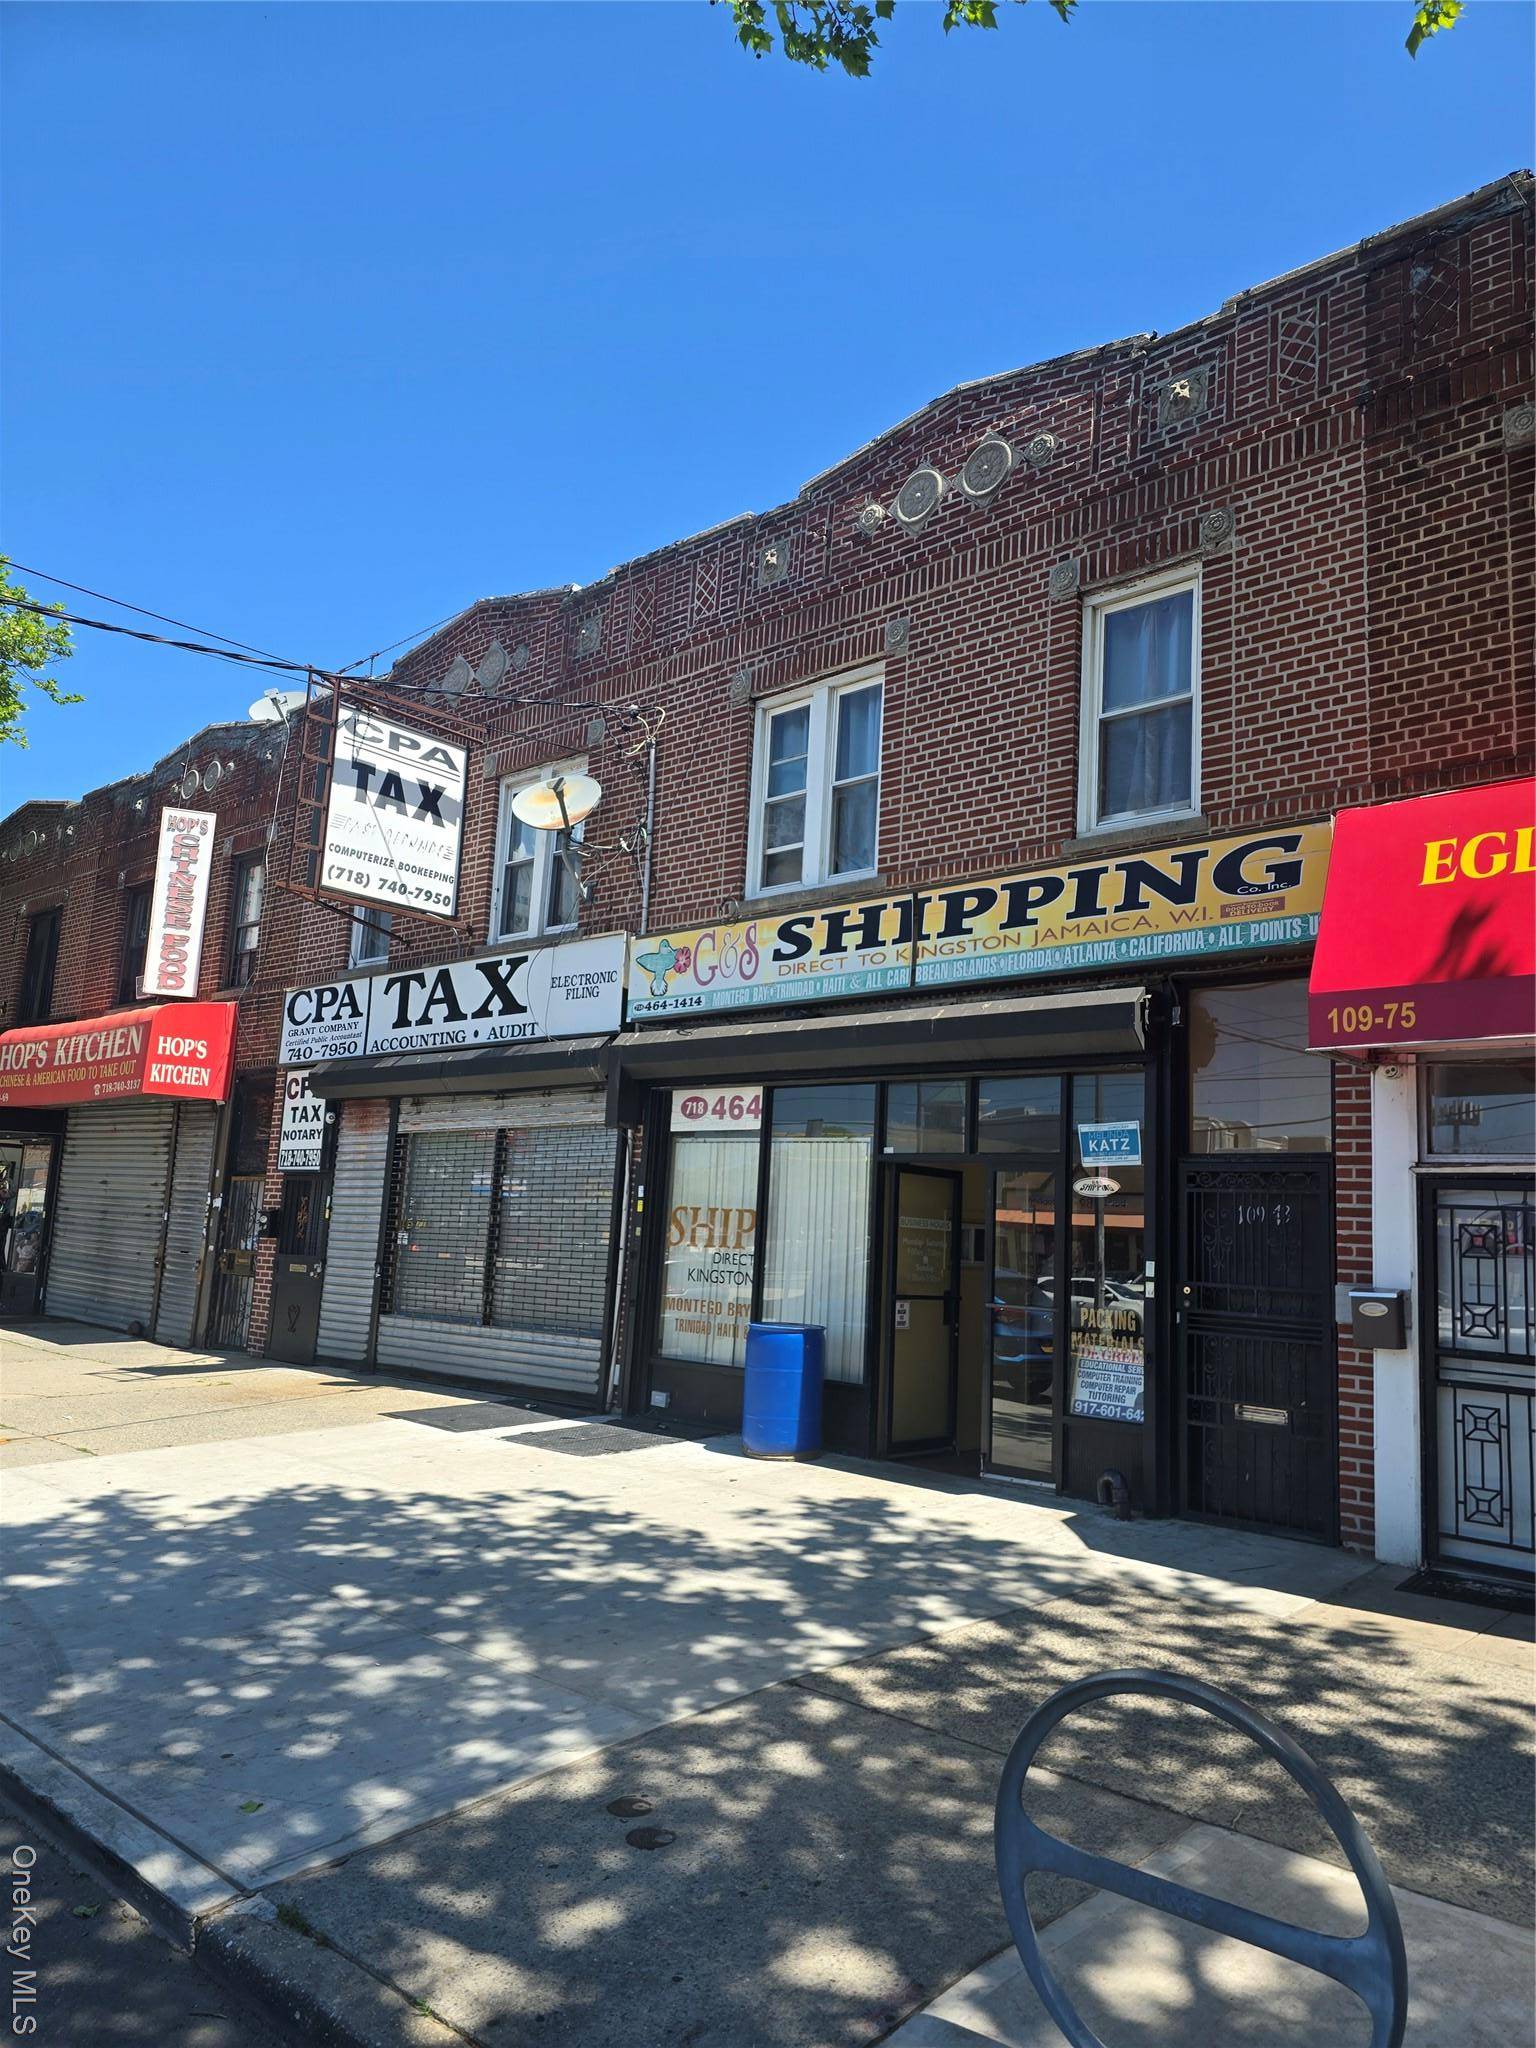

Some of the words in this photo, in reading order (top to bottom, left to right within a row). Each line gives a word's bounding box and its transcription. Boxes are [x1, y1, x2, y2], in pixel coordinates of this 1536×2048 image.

[345, 719, 460, 772] CPA
[352, 761, 447, 828] TAX
[166, 815, 208, 835] HOP'S
[328, 843, 396, 869] COMPUTERIZE
[398, 861, 455, 884] BOOKEEPING
[164, 834, 199, 931] CHINESE
[327, 864, 371, 888] (718)
[378, 877, 452, 907] 740-7950
[1267, 882, 1291, 890] Inc.
[772, 834, 1303, 962] SHIPPING
[1230, 906, 1274, 917] DELIVERY
[778, 957, 848, 976] DIRECT
[858, 952, 886, 966] TO
[896, 932, 1029, 961] KINGSTON
[1033, 916, 1159, 945] JAMAICA,
[1168, 906, 1213, 926] W.I.
[156, 934, 189, 990] FOOD
[712, 989, 749, 1007] MONTEGO
[753, 985, 768, 1001] BAY
[776, 980, 814, 999] TRINIDAD
[822, 977, 846, 993] HAITI
[850, 975, 861, 989] &
[866, 971, 882, 988] ALL
[887, 962, 948, 986] CARIBBEAN
[953, 956, 996, 977] ISLANDS
[1008, 950, 1052, 972] FLORIDA
[1065, 942, 1117, 964] ATLANTA
[1129, 930, 1204, 956] CALIFORNIA
[1219, 925, 1243, 946] ALL
[1250, 917, 1301, 943] POINTS
[287, 984, 363, 1026] CPA
[383, 955, 529, 1030] TAX
[551, 970, 618, 990] ELECTRONIC
[565, 986, 602, 1001] FILING
[1328, 1001, 1416, 1033] 109-75
[288, 1027, 316, 1038] GRANT
[319, 1022, 359, 1033] COMPANY
[370, 1029, 466, 1053] ACCOUNTING
[487, 1022, 539, 1040] AUDIT
[0, 1040, 48, 1070] HOP'S
[54, 1024, 144, 1065] KITCHEN
[157, 1036, 207, 1060] HOP'S
[288, 1041, 358, 1061] 740-7950
[33, 1070, 65, 1085] AMERICAN
[67, 1067, 87, 1082] FOOD
[88, 1066, 98, 1079] TO
[100, 1062, 119, 1077] TAKE
[120, 1060, 137, 1075] OUT
[150, 1064, 210, 1086] KITCHEN
[291, 1105, 322, 1123] TAX
[686, 1102, 704, 1115] 718
[711, 1095, 762, 1120] 464
[283, 1129, 323, 1141] NOTARY
[1089, 1138, 1130, 1151] KATZ
[667, 1206, 757, 1249] SHIP
[713, 1252, 754, 1266] DIRECT
[664, 1298, 722, 1315] MONTEGO
[728, 1302, 751, 1317] BAY
[675, 1319, 711, 1335] TRINIDAD
[717, 1322, 739, 1338] HAITI
[1081, 1308, 1136, 1331] PACKING
[1071, 1332, 1144, 1352] MATERIALS
[1081, 1360, 1126, 1372] EDUCATIONAL
[1078, 1370, 1111, 1380] COMPUTER
[1113, 1375, 1142, 1385] TRAINING
[1081, 1381, 1113, 1391] COMPUTER
[1114, 1385, 1136, 1395] REPAIR
[1089, 1392, 1126, 1403] TUTORING
